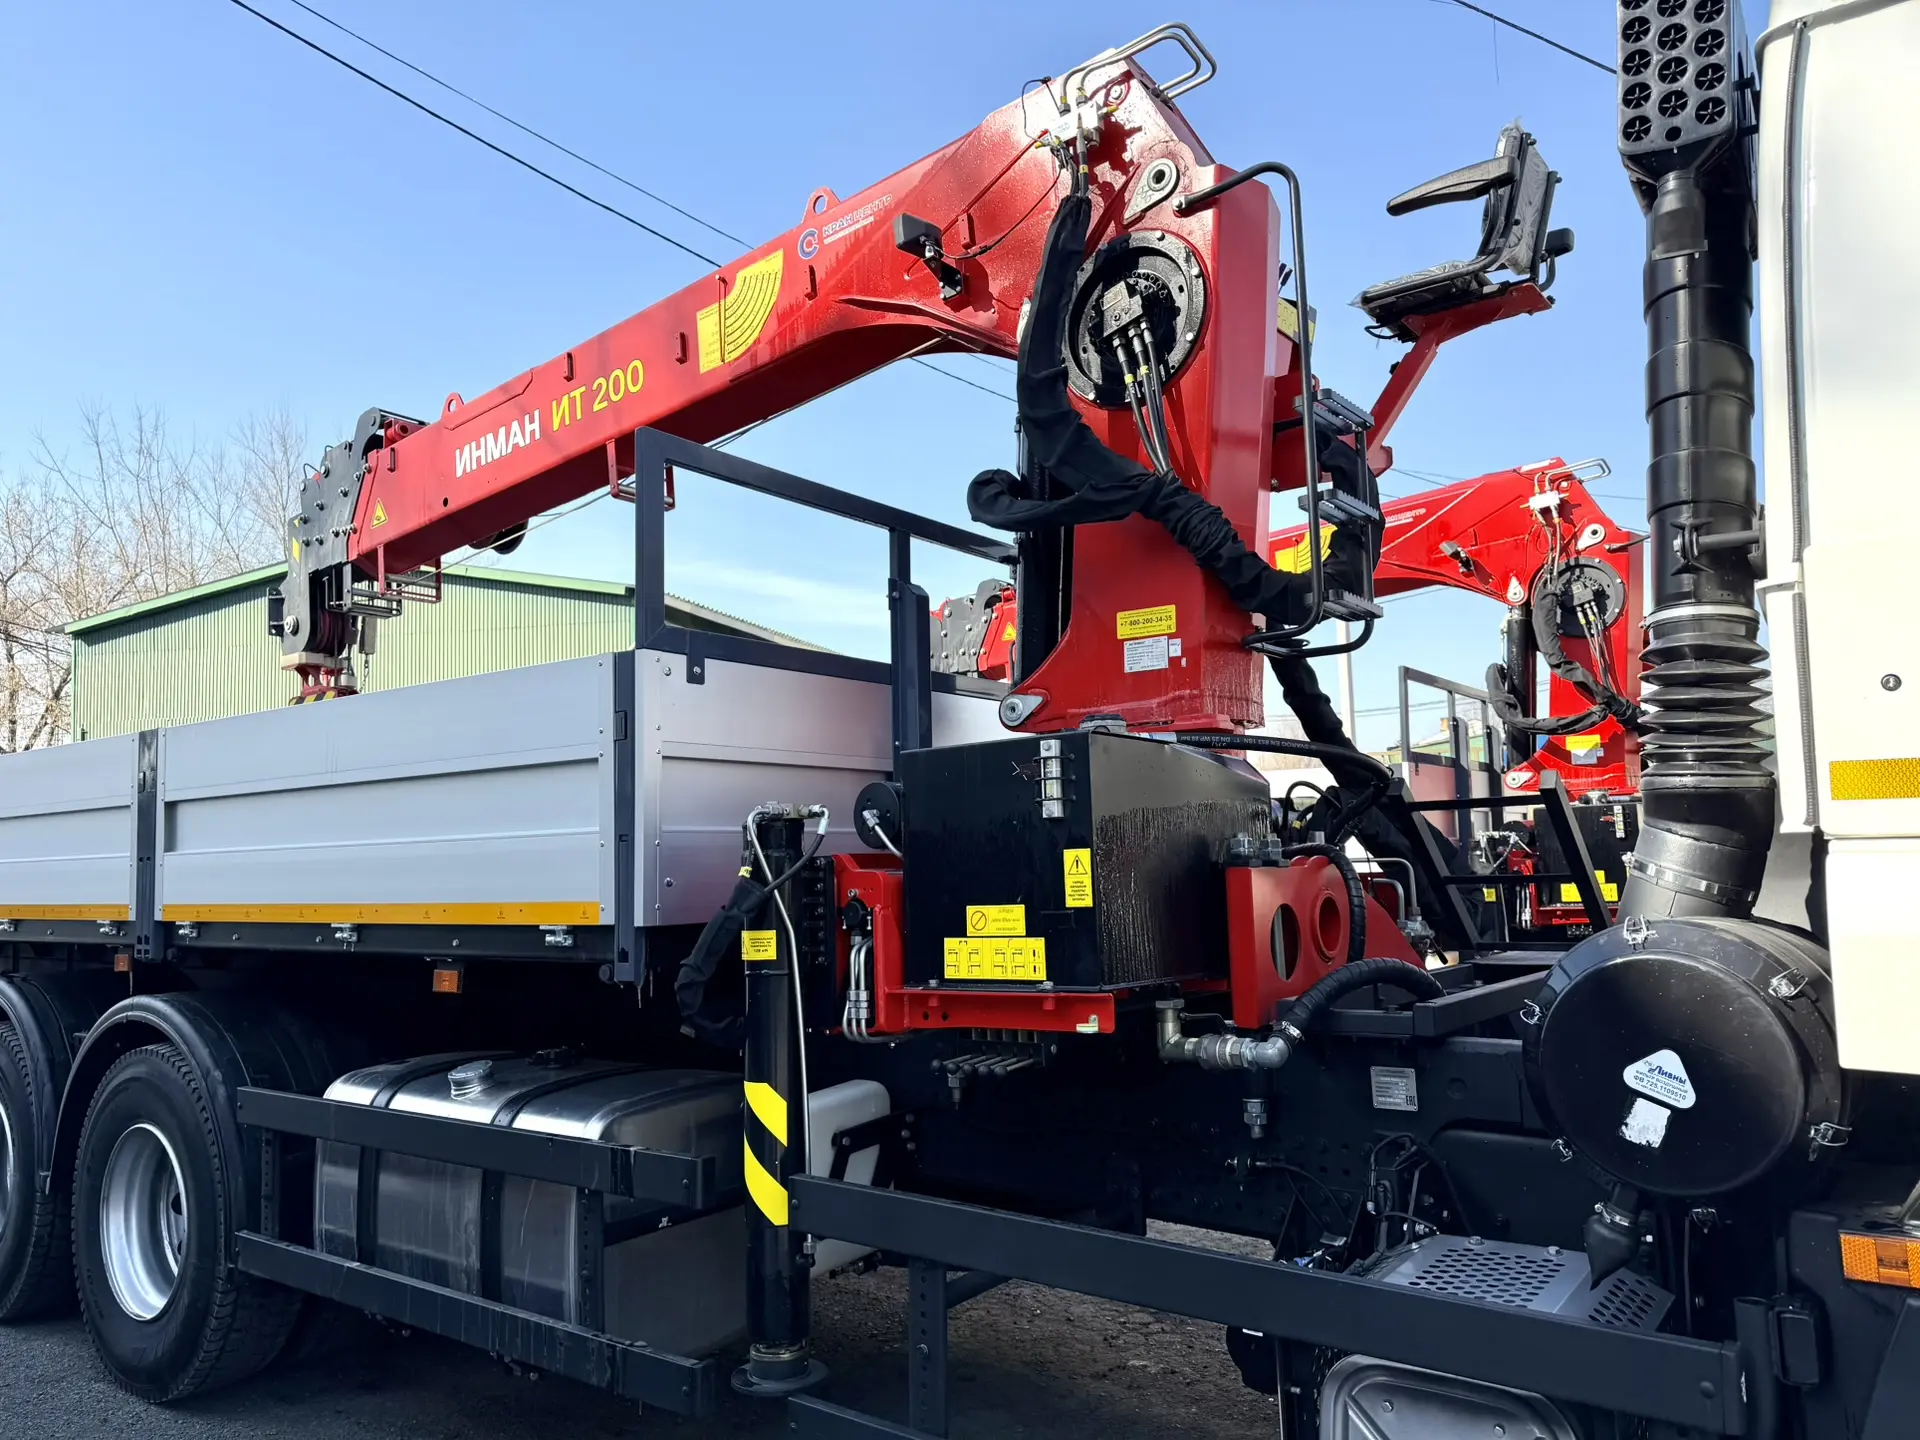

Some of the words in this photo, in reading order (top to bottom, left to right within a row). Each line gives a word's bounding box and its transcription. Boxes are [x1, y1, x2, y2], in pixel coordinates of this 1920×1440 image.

[455, 408, 541, 479] ИНМАН
[551, 385, 587, 432] ИТ
[592, 359, 644, 412] 200
[1651, 1065, 1686, 1085] Ливны
